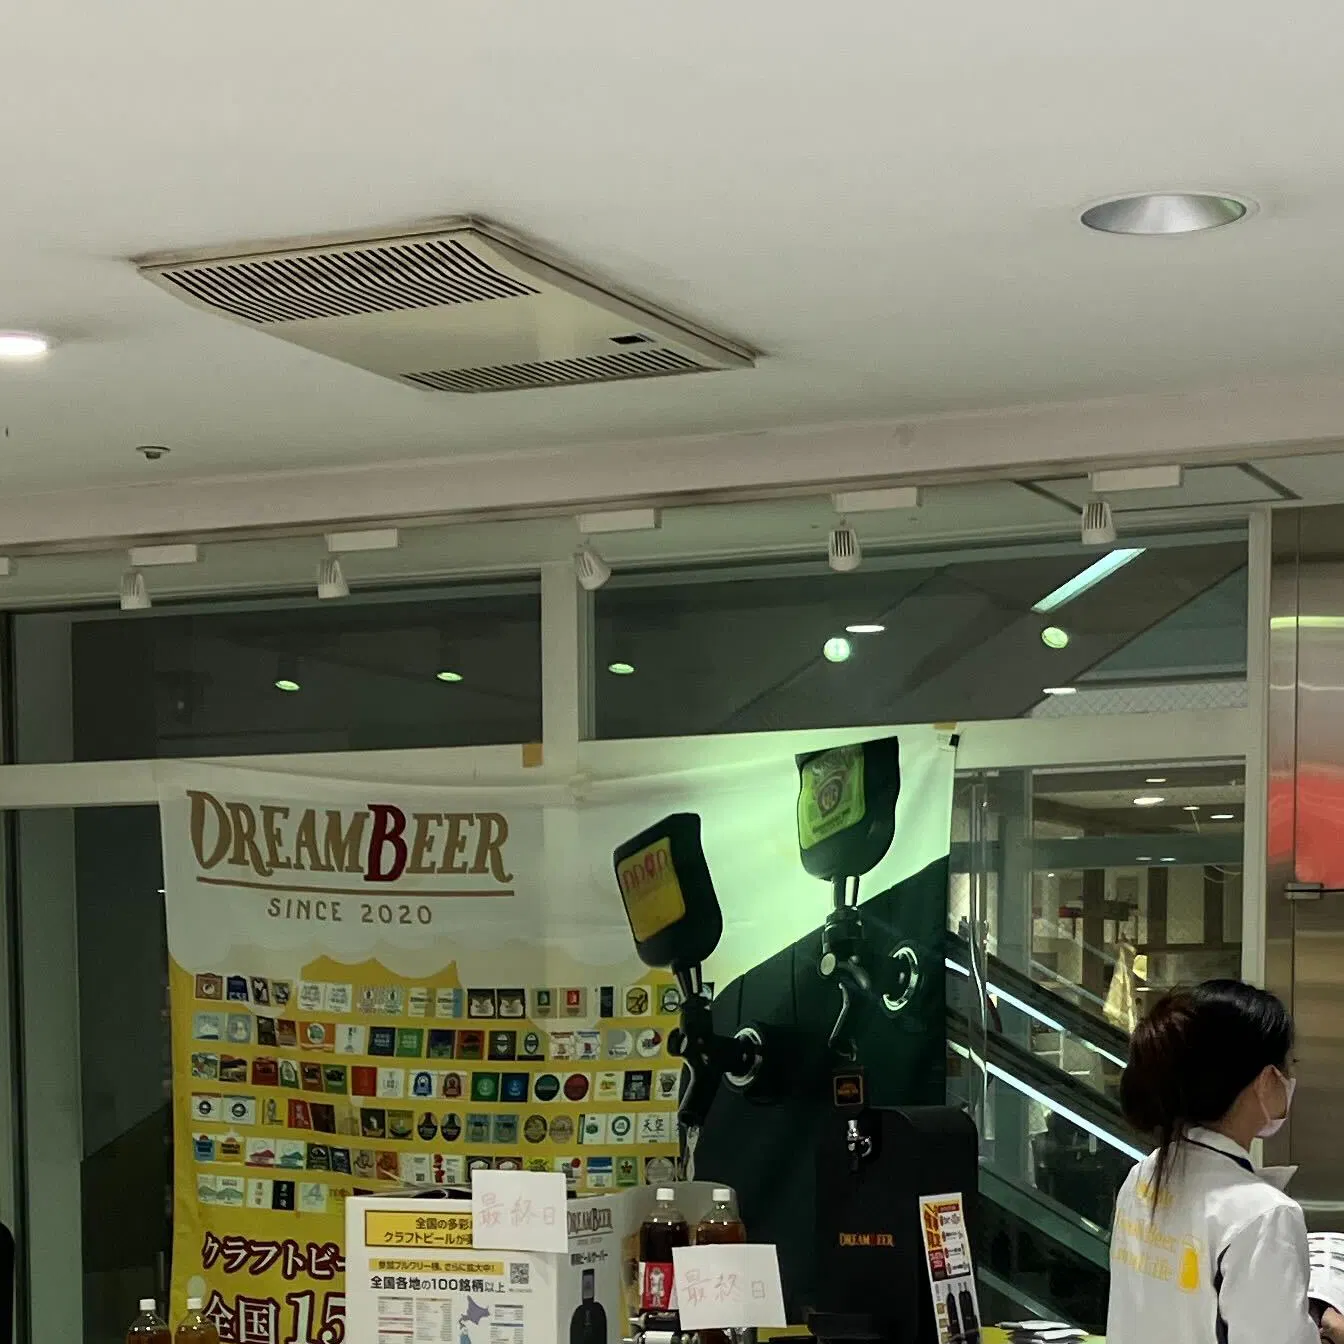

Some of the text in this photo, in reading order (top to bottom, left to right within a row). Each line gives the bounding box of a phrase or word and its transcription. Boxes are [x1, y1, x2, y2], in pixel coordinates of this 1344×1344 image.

[186, 789, 514, 884] DREAMBEER
[267, 898, 433, 925] SINCE 2020
[415, 1217, 473, 1231] 全国の多彩
[477, 1192, 556, 1227] 最終日
[203, 1231, 346, 1279] クラフトビ
[681, 1268, 766, 1306] 最終日
